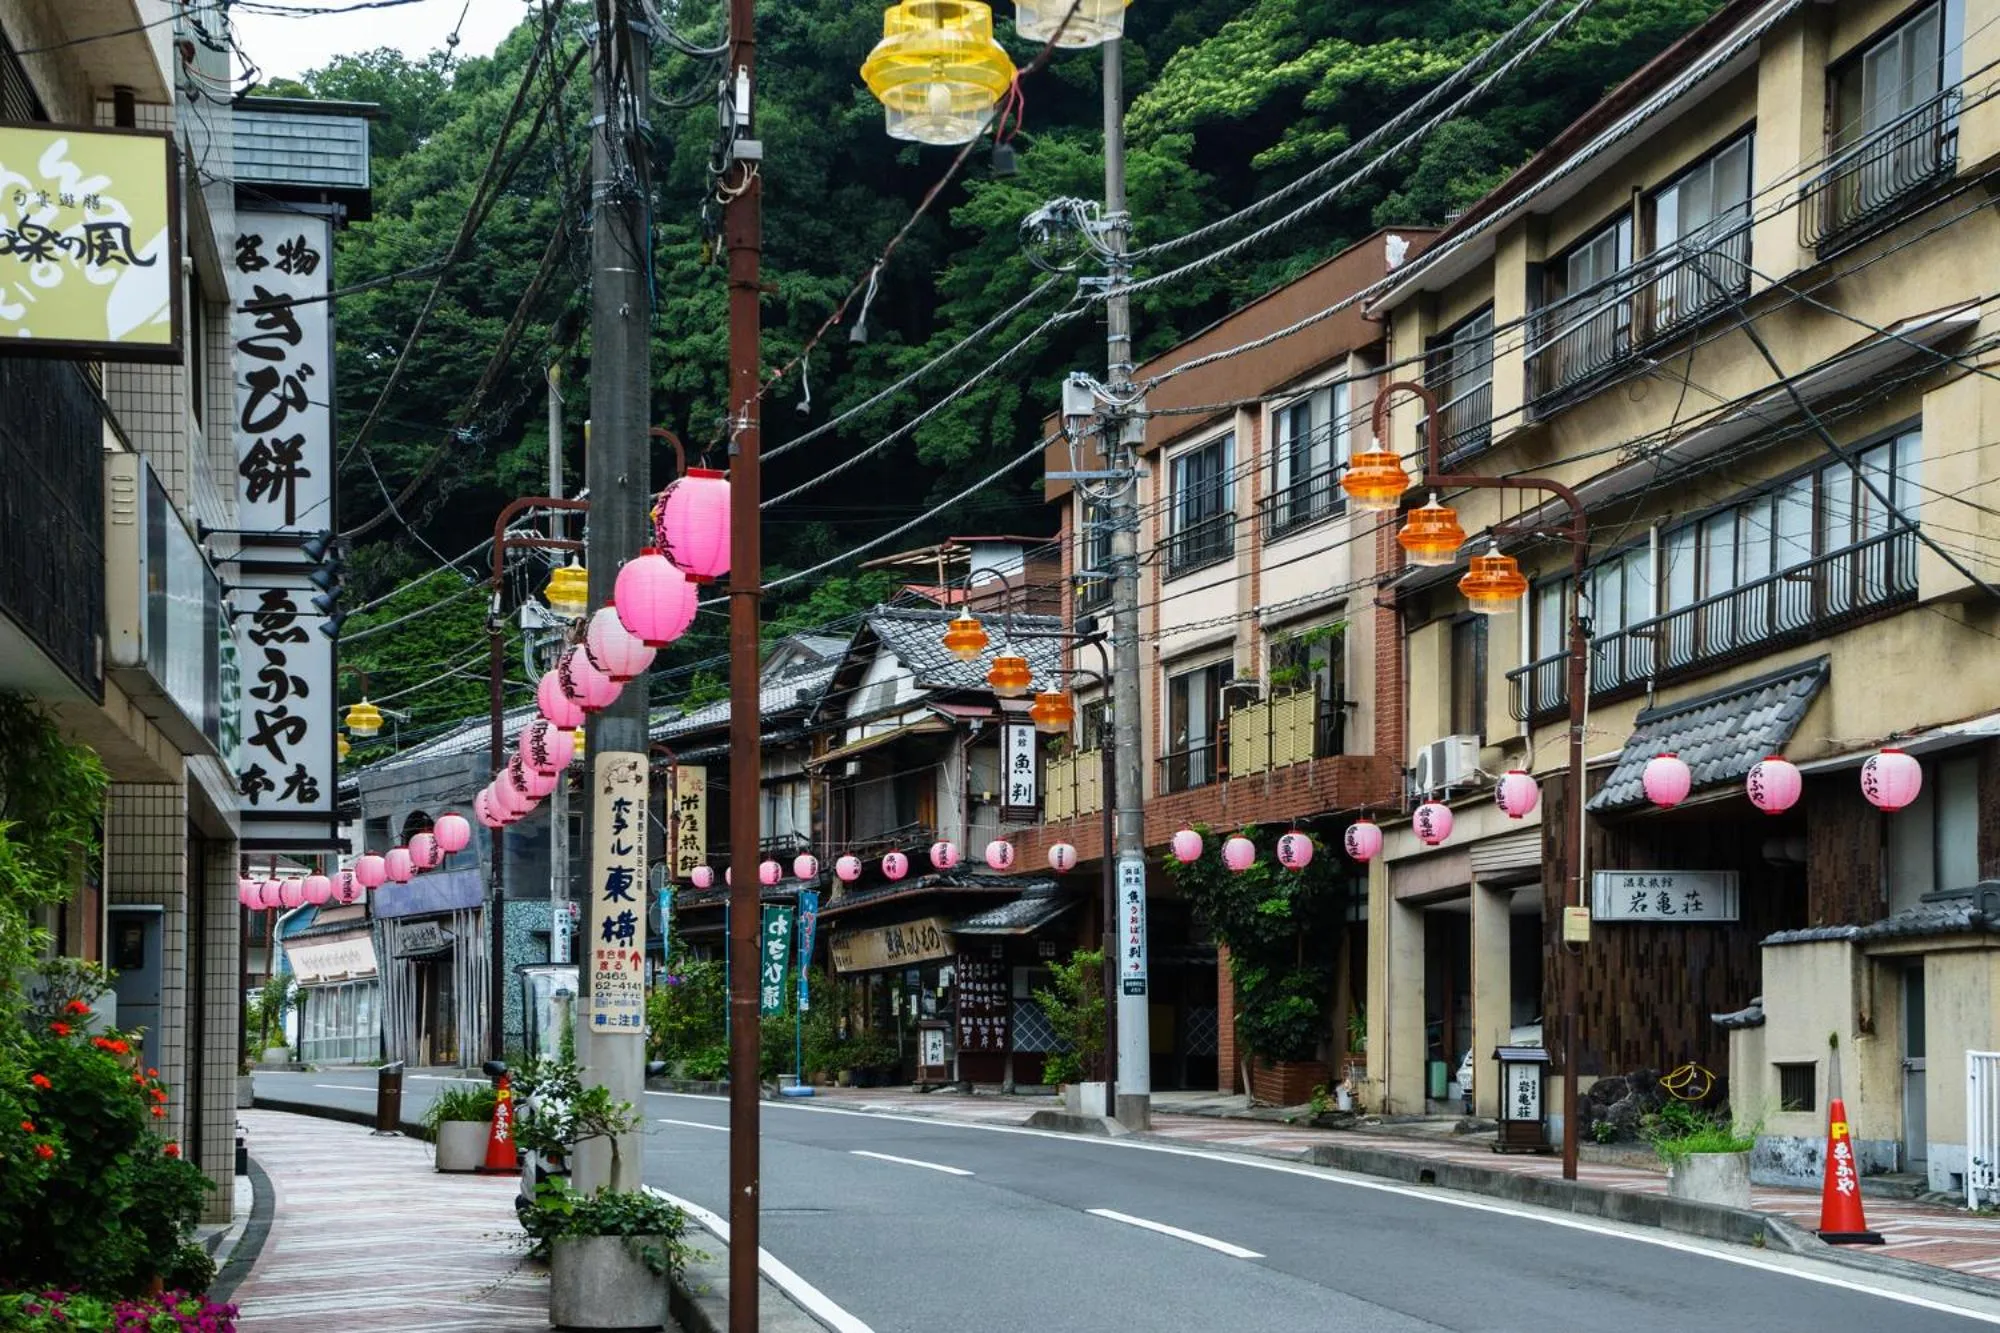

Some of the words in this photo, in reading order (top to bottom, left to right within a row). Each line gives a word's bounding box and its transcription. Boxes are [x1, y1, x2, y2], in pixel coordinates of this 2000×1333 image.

[235, 233, 321, 276] 名物
[237, 285, 314, 526] きび餅
[239, 763, 320, 807] 本店
[1012, 753, 1033, 803] 魚判
[601, 797, 638, 947] ホテル東横
[1624, 876, 1674, 888] 温泉旅館
[1628, 890, 1704, 915] 岩亀荘
[595, 972, 627, 981] 0465
[595, 981, 641, 991] 62-4141
[595, 1013, 640, 1026] 車に注意
[498, 1090, 509, 1101] P
[1517, 1081, 1531, 1118] 岩亀荘
[1832, 1122, 1848, 1139] P
